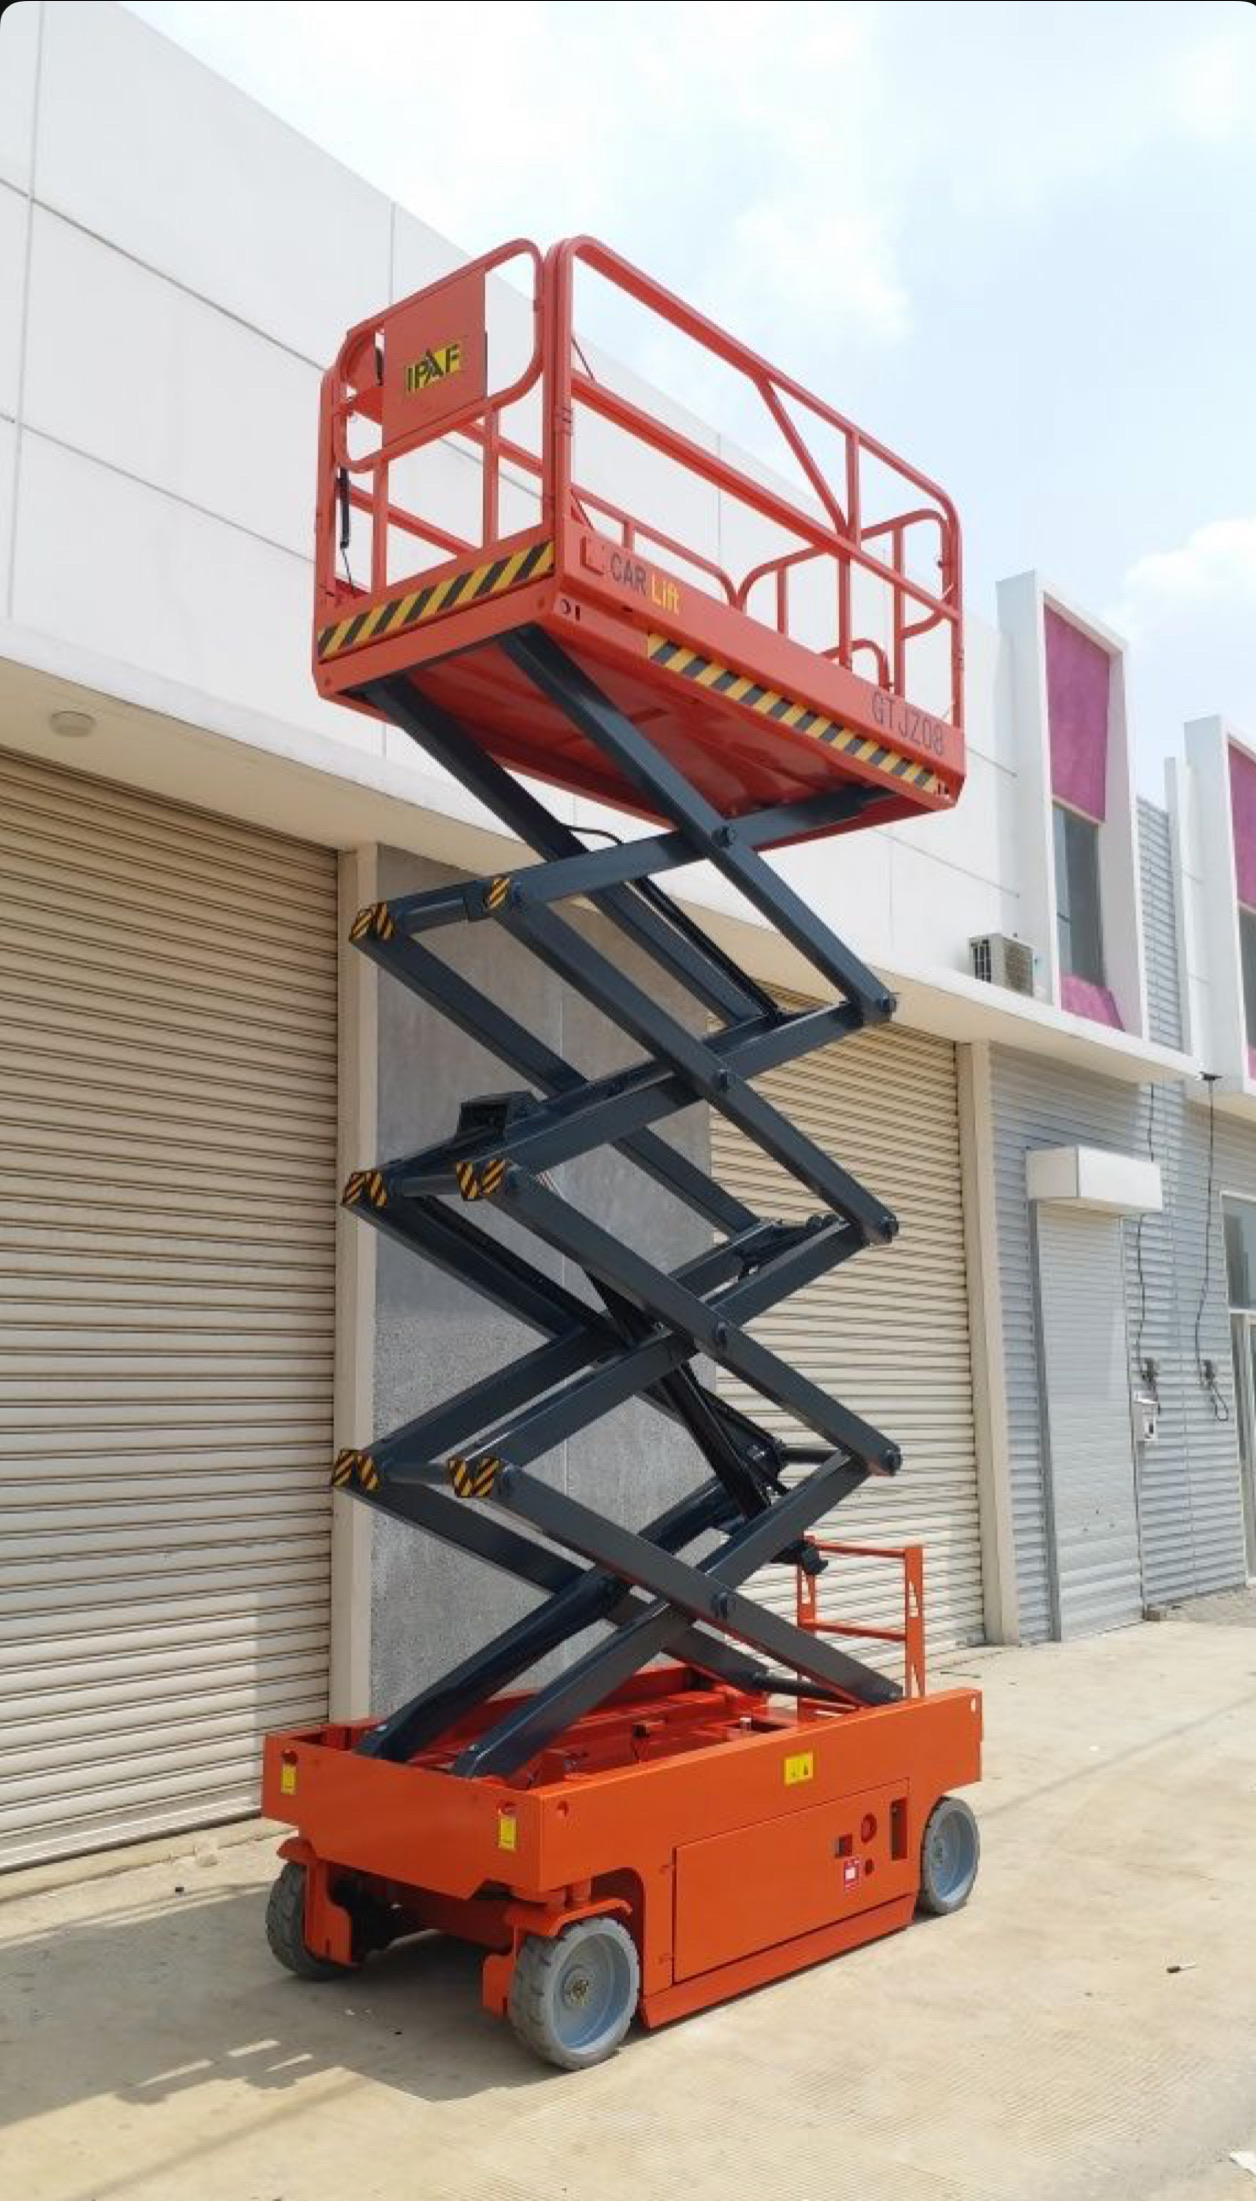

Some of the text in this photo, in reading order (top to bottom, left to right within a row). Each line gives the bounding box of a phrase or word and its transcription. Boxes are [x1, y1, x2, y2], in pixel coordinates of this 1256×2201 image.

[408, 343, 460, 391] IPAF
[611, 552, 680, 615] CAR Lift
[872, 690, 944, 756] GTJZ08
